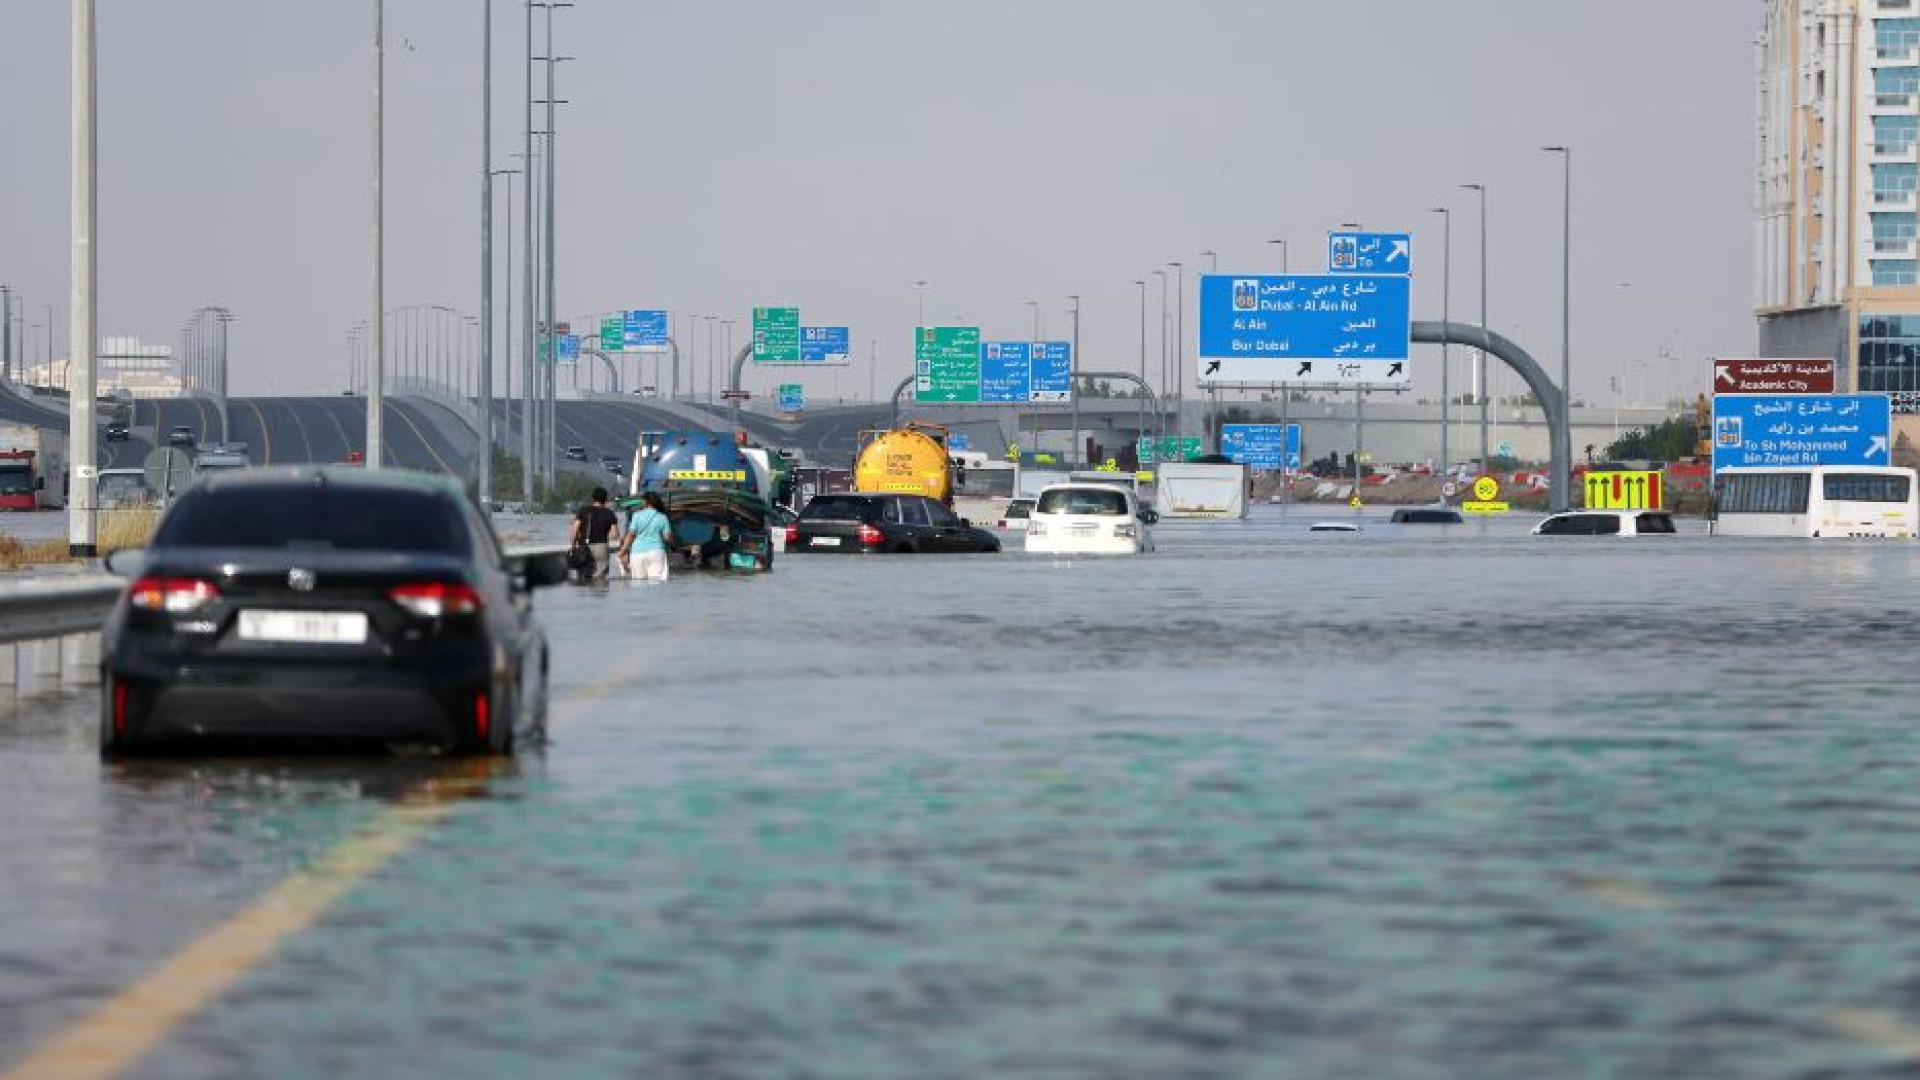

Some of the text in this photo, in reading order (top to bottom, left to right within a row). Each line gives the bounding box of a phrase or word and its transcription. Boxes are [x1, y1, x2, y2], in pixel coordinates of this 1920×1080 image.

[1358, 256, 1373, 267] To
[1261, 280, 1295, 294] العين
[1312, 283, 1336, 298] دبي
[1343, 280, 1377, 298] شارع
[1261, 300, 1294, 311] Dubai
[1304, 300, 1318, 311] Al
[1319, 300, 1338, 311] Ain
[1341, 300, 1357, 311] Rd
[1233, 318, 1266, 330] Al Ain
[1342, 318, 1376, 332] العين
[1232, 339, 1289, 351] Bur Dubai
[1333, 340, 1360, 356] دبي
[1796, 363, 1832, 375] المدينة
[1739, 380, 1808, 391] Academic City
[1754, 400, 1859, 417] إلى شارع الشيخ
[1768, 421, 1859, 435] محمد بن زايد
[1744, 440, 1847, 451] To Sh Mohammed
[1744, 452, 1818, 465] bin Zayed Rd
